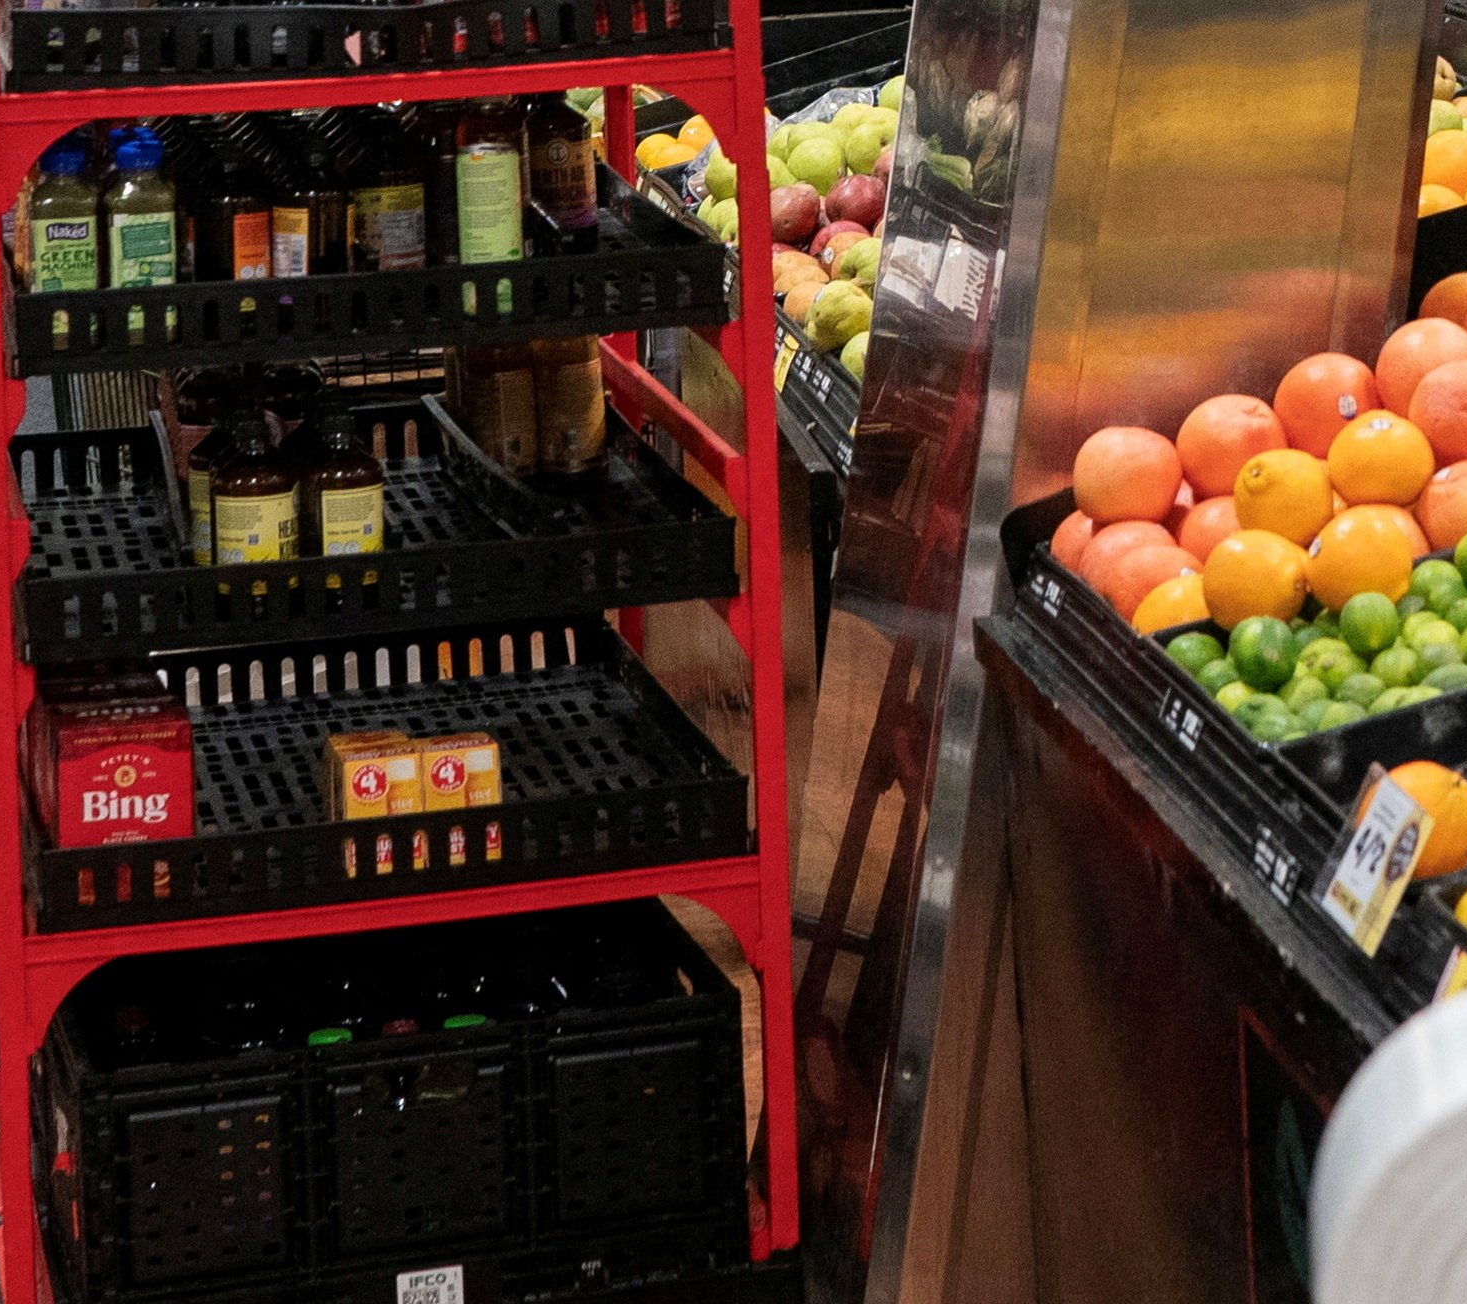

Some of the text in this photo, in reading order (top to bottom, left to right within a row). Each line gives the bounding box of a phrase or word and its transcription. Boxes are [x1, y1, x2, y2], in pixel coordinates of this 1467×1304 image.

[47, 224, 88, 240] Naked
[41, 249, 95, 262] GREEN
[360, 772, 377, 793] 4
[438, 763, 456, 784] 4
[83, 790, 170, 823] Bing
[409, 1272, 446, 1289] IFCO
